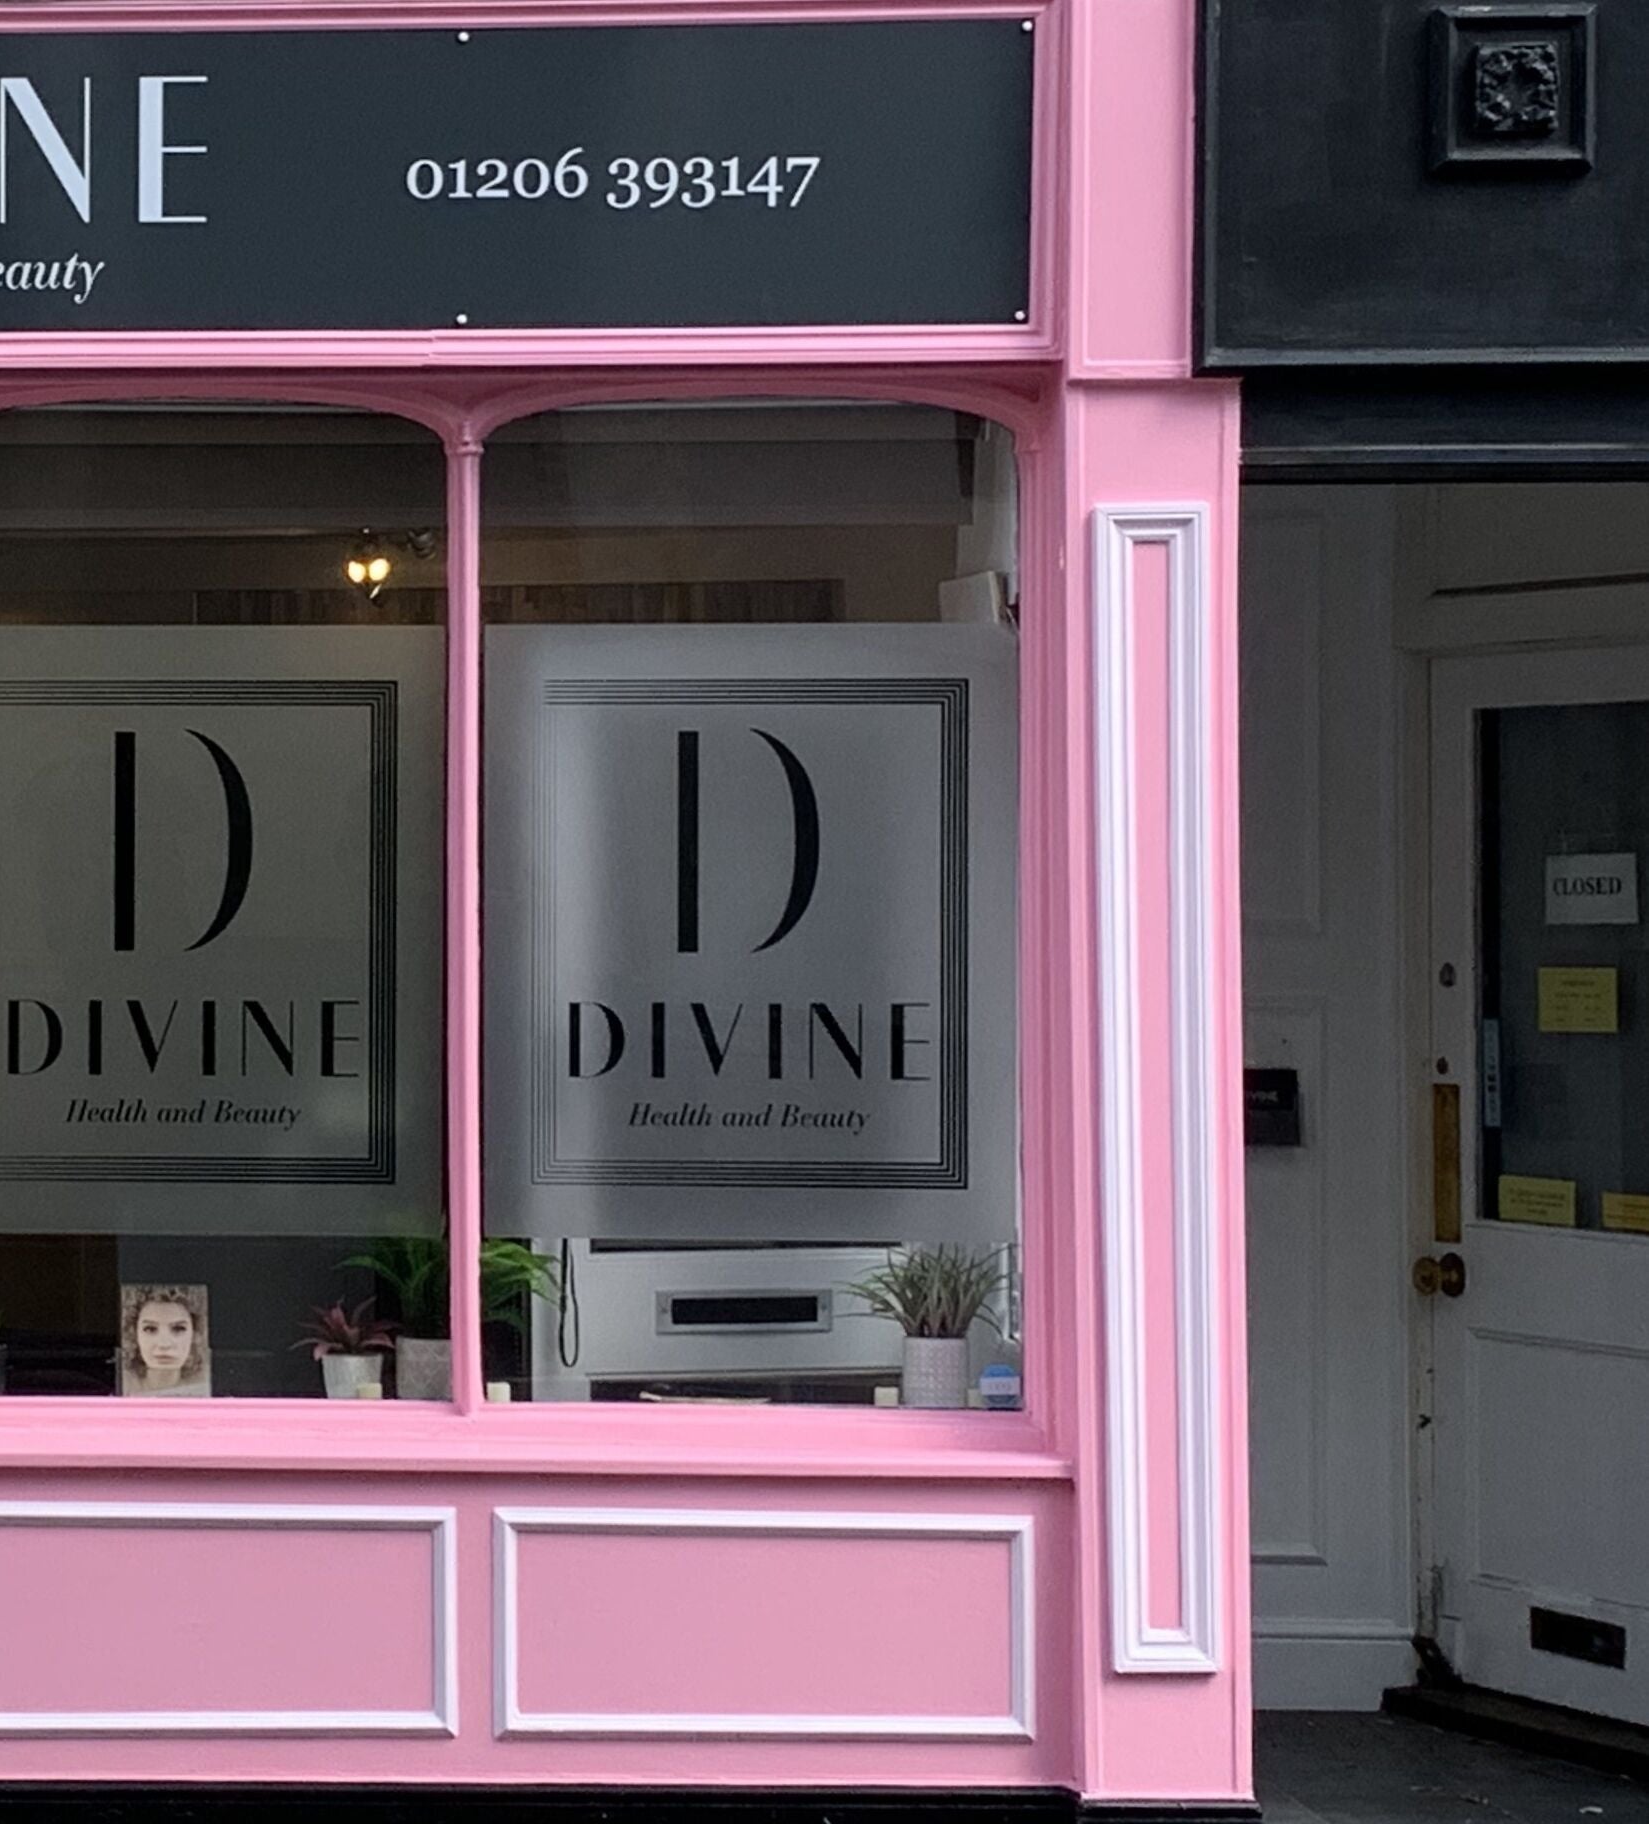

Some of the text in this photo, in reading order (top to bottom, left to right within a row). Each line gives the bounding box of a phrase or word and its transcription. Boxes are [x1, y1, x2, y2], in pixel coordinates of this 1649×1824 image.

[406, 147, 821, 209] 01206 393147
[112, 729, 254, 953] D
[676, 728, 820, 954] D
[1552, 876, 1623, 897] CLOSED
[6, 999, 360, 1078] DIVINE
[568, 1001, 929, 1081] DIVINE
[66, 1098, 302, 1131] Health and Beauty
[628, 1102, 871, 1136] Health and Beauty
